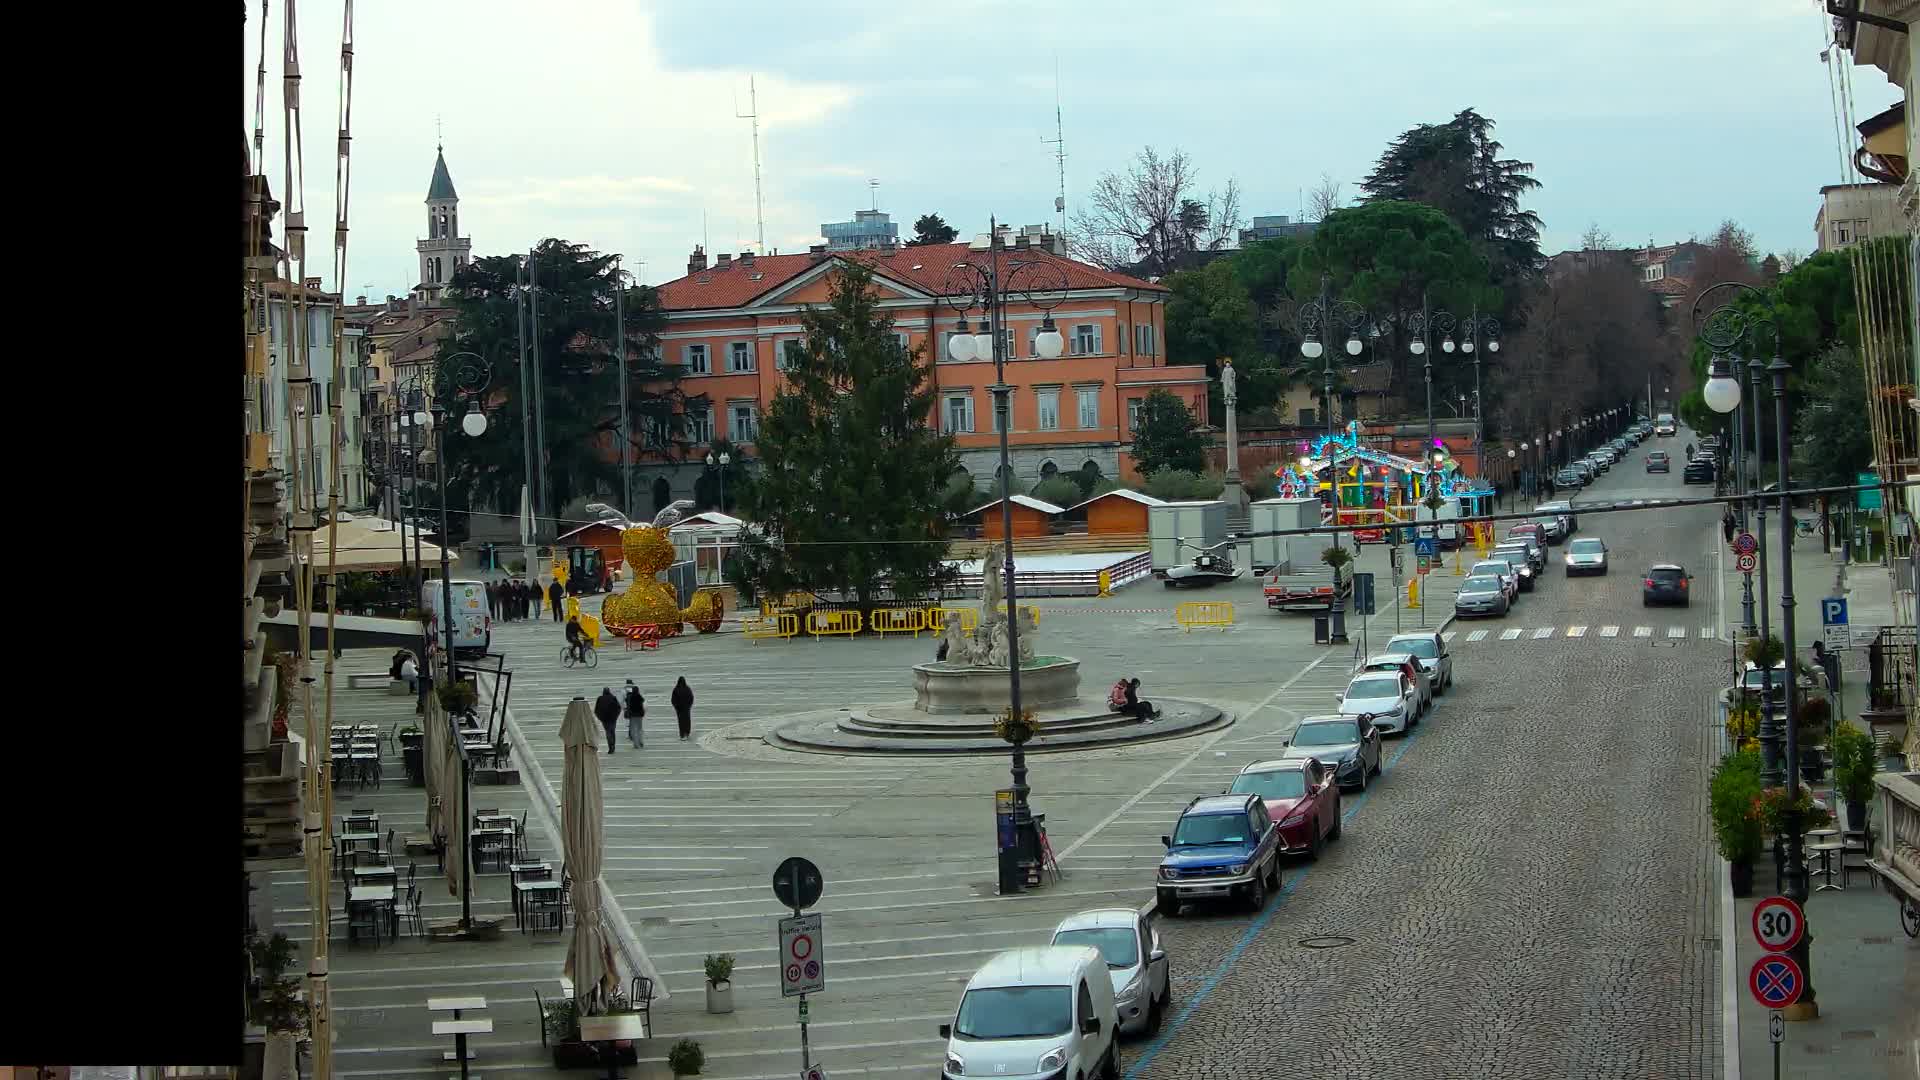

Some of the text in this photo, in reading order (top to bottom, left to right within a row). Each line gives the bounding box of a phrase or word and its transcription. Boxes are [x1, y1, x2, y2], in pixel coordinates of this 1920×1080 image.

[1742, 557, 1753, 567] 20
[1827, 602, 1842, 622] P
[1762, 911, 1792, 937] 30
